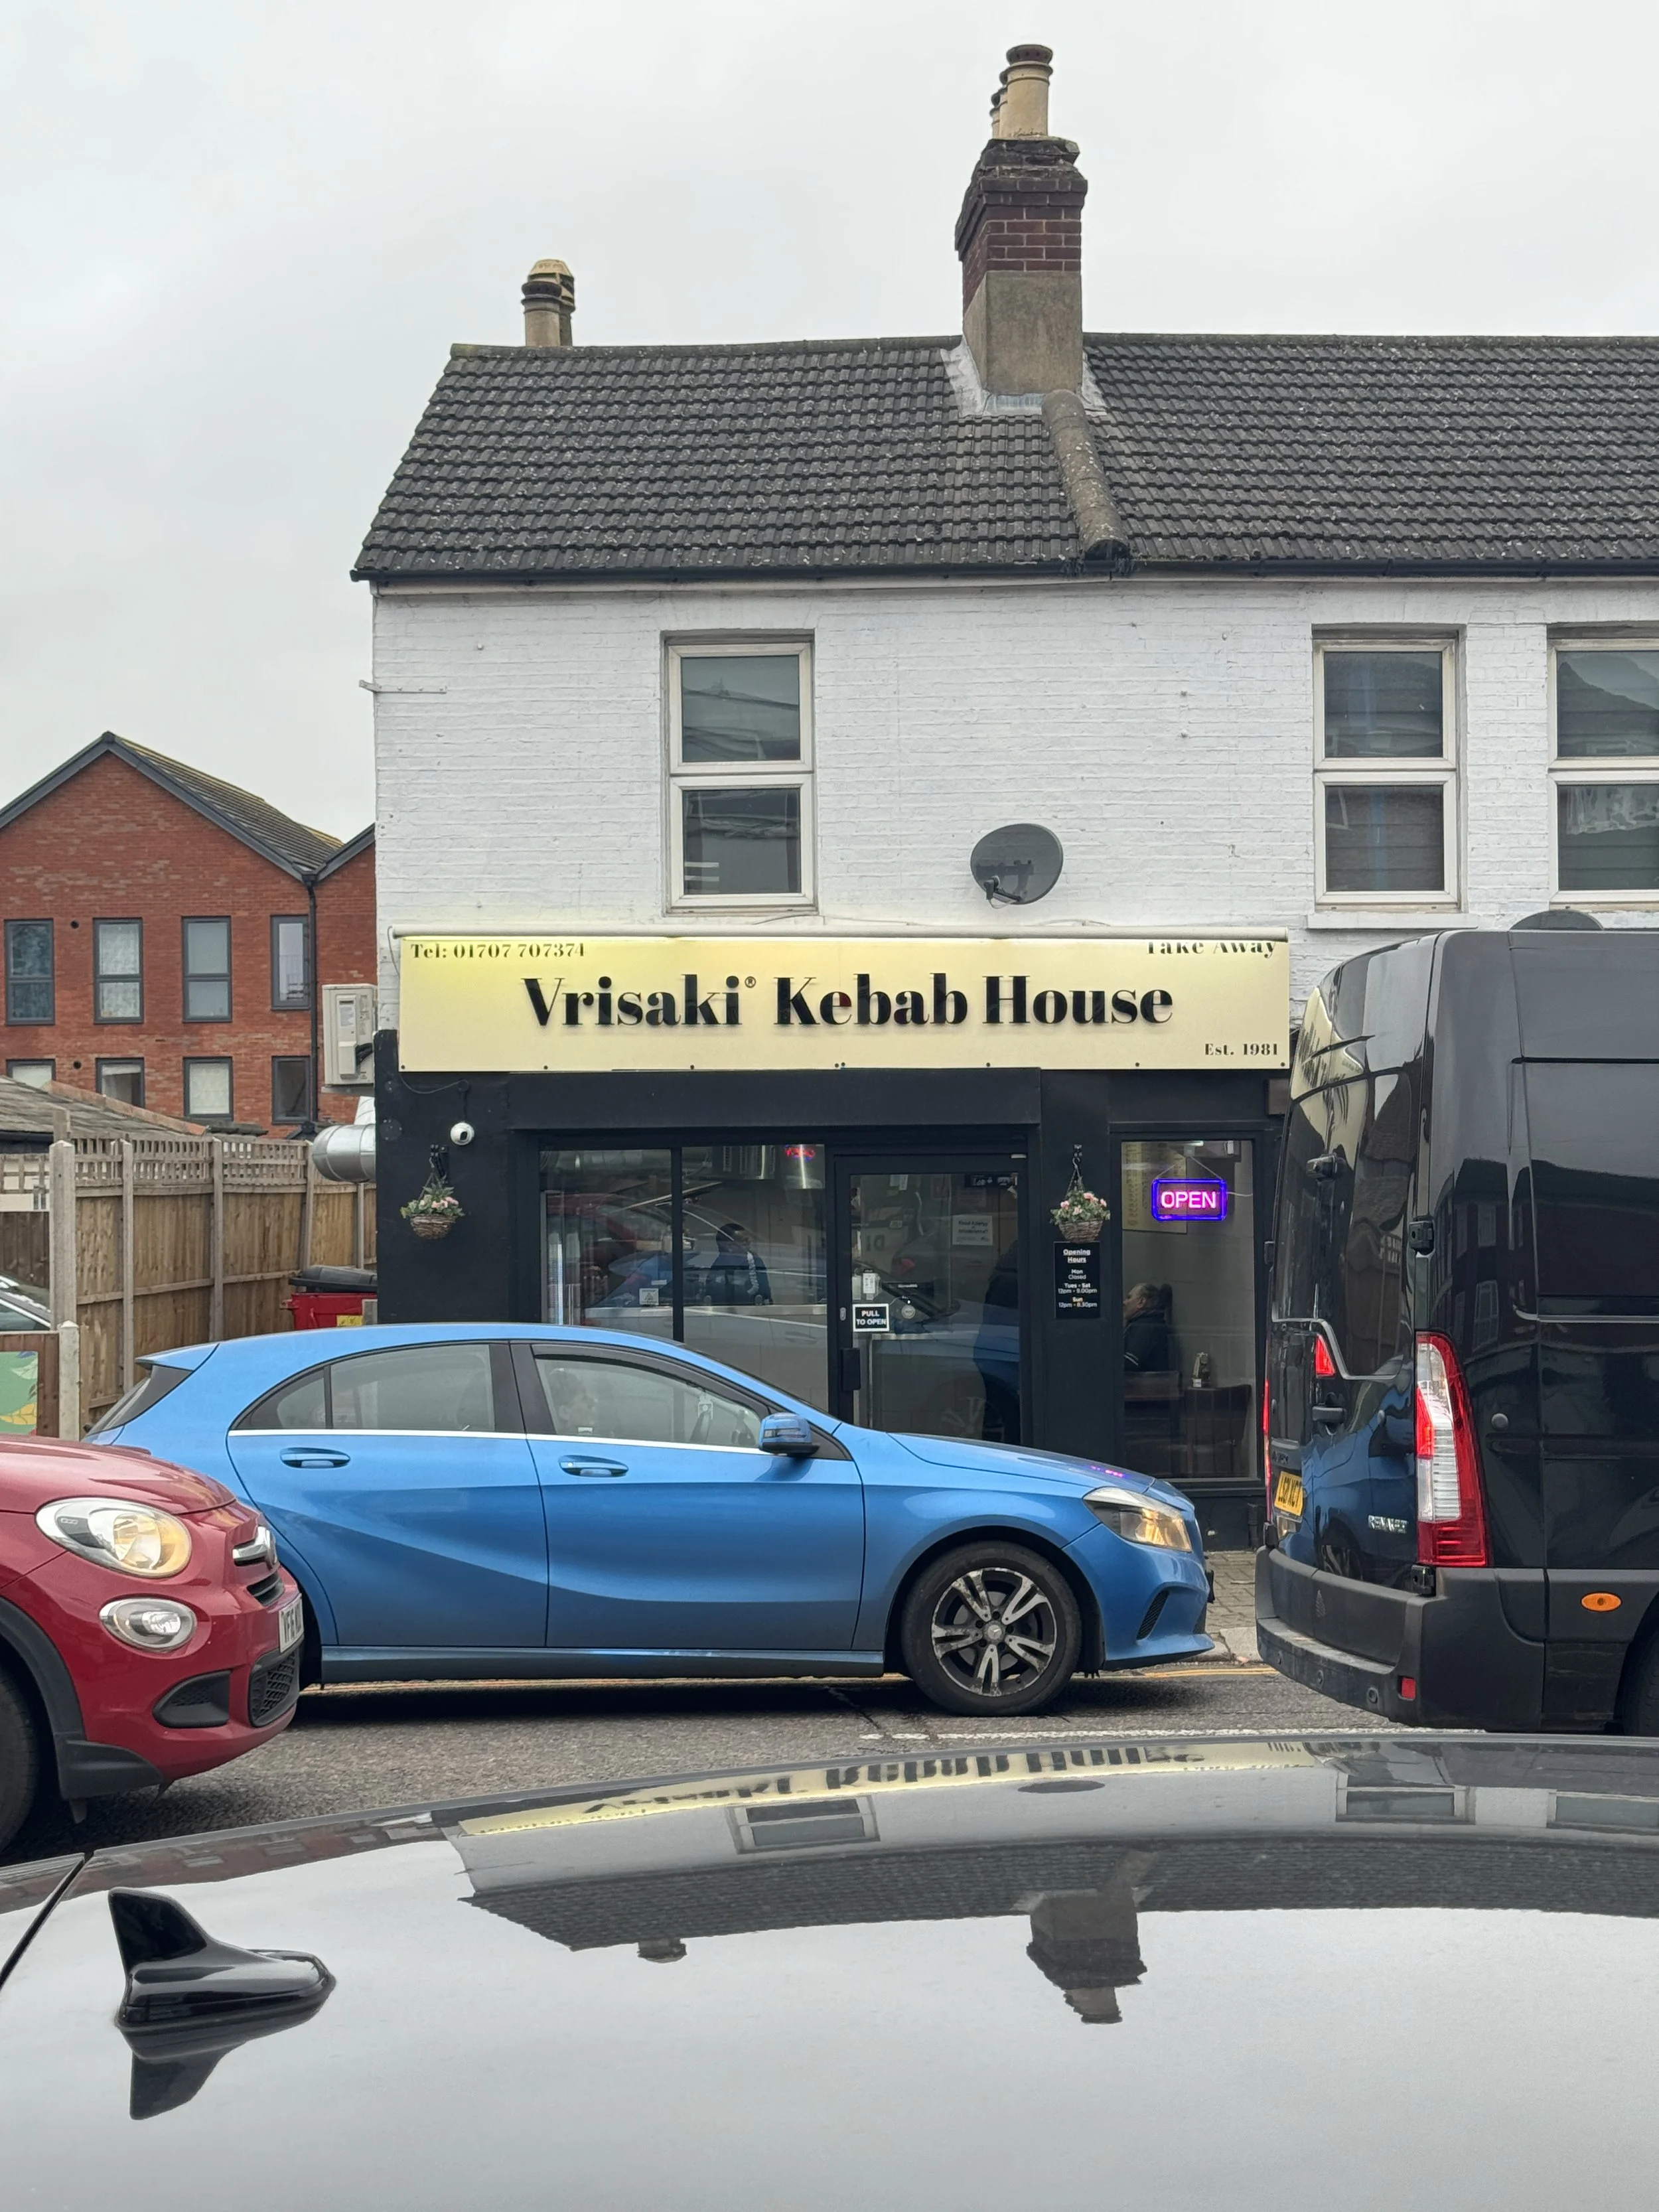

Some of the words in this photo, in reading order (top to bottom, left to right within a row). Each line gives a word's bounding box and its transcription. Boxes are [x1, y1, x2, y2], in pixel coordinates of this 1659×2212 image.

[411, 943, 447, 958] Tel:
[453, 943, 511, 958] 01707
[518, 942, 585, 958] 707374
[1213, 941, 1275, 958] Away
[774, 973, 968, 1025] Kebab
[982, 976, 1174, 1025] House
[1205, 1043, 1234, 1055] Est.
[1243, 1043, 1277, 1055] 1981
[1161, 1191, 1216, 1209] OPEN
